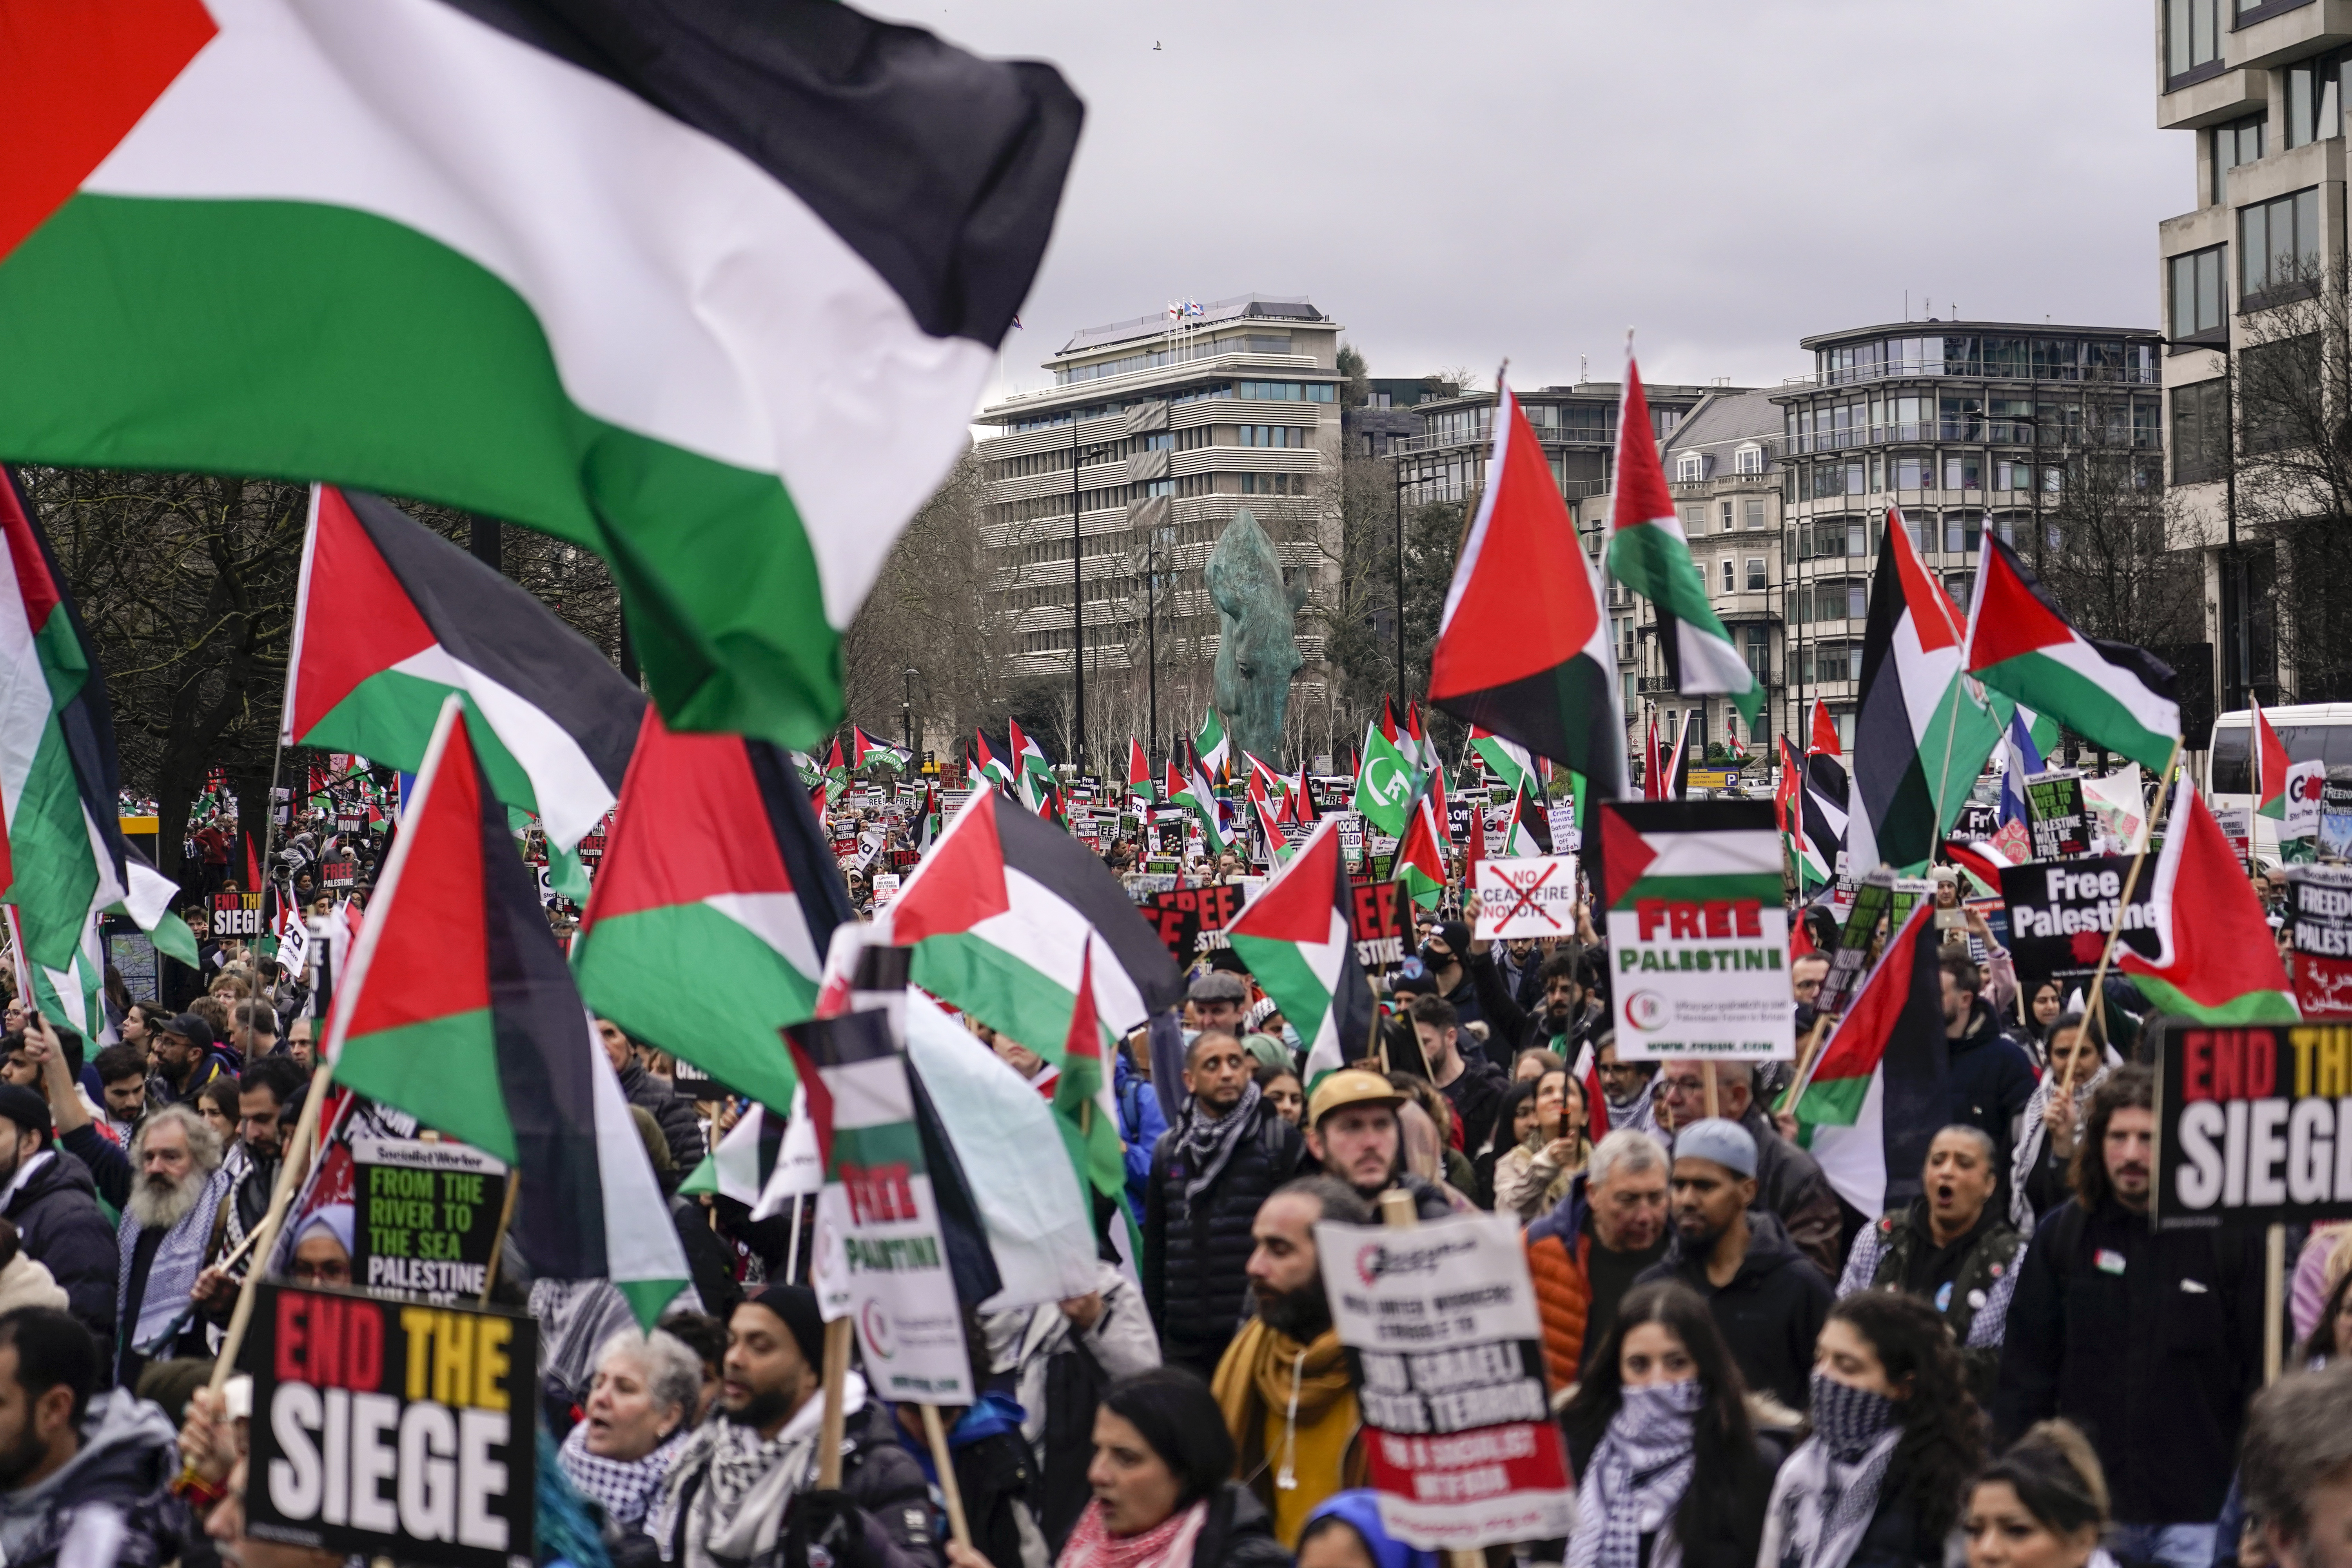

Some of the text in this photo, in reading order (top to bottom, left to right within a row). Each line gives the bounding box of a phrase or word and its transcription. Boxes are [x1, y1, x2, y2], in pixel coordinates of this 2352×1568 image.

[1727, 774, 1736, 785] P
[2056, 780, 2074, 792] THE
[1324, 795, 1342, 805] FRE
[2057, 793, 2071, 805] TO
[1454, 810, 1468, 820] Off
[1553, 809, 1571, 818] Crime
[2051, 805, 2069, 818] SEA
[338, 820, 359, 831] NOW
[2033, 815, 2082, 833] PALESTINE
[2223, 821, 2243, 829] ISRAELI
[836, 832, 855, 840] PALESTINE
[2059, 829, 2072, 841] BE
[2225, 828, 2246, 837] TERROR
[1556, 844, 1579, 853] Rafah
[894, 850, 920, 865] FREE
[323, 864, 352, 880] FREE
[1513, 871, 1537, 884] NO
[323, 878, 353, 887] PALESTINE
[1836, 883, 1853, 891] STATE
[2045, 868, 2120, 902] Free
[214, 894, 238, 910] END
[2298, 883, 2352, 918] FREED
[1484, 904, 1547, 918] NO VOTE
[214, 910, 264, 934] SIEGE
[1635, 898, 1762, 942] FREE
[2012, 899, 2158, 939] Palestine
[1354, 936, 1406, 966] STINE
[1619, 949, 1784, 973] PALESTINE
[2181, 1025, 2352, 1103] END TH
[377, 1146, 483, 1166] Socialist Worker
[370, 1167, 485, 1204] FROM THE
[369, 1196, 472, 1232] RIVER TO
[368, 1226, 461, 1260] THE SEA
[367, 1255, 488, 1294] PALESTINE
[276, 1289, 514, 1412] END THE
[268, 1379, 511, 1551] SIEGE
